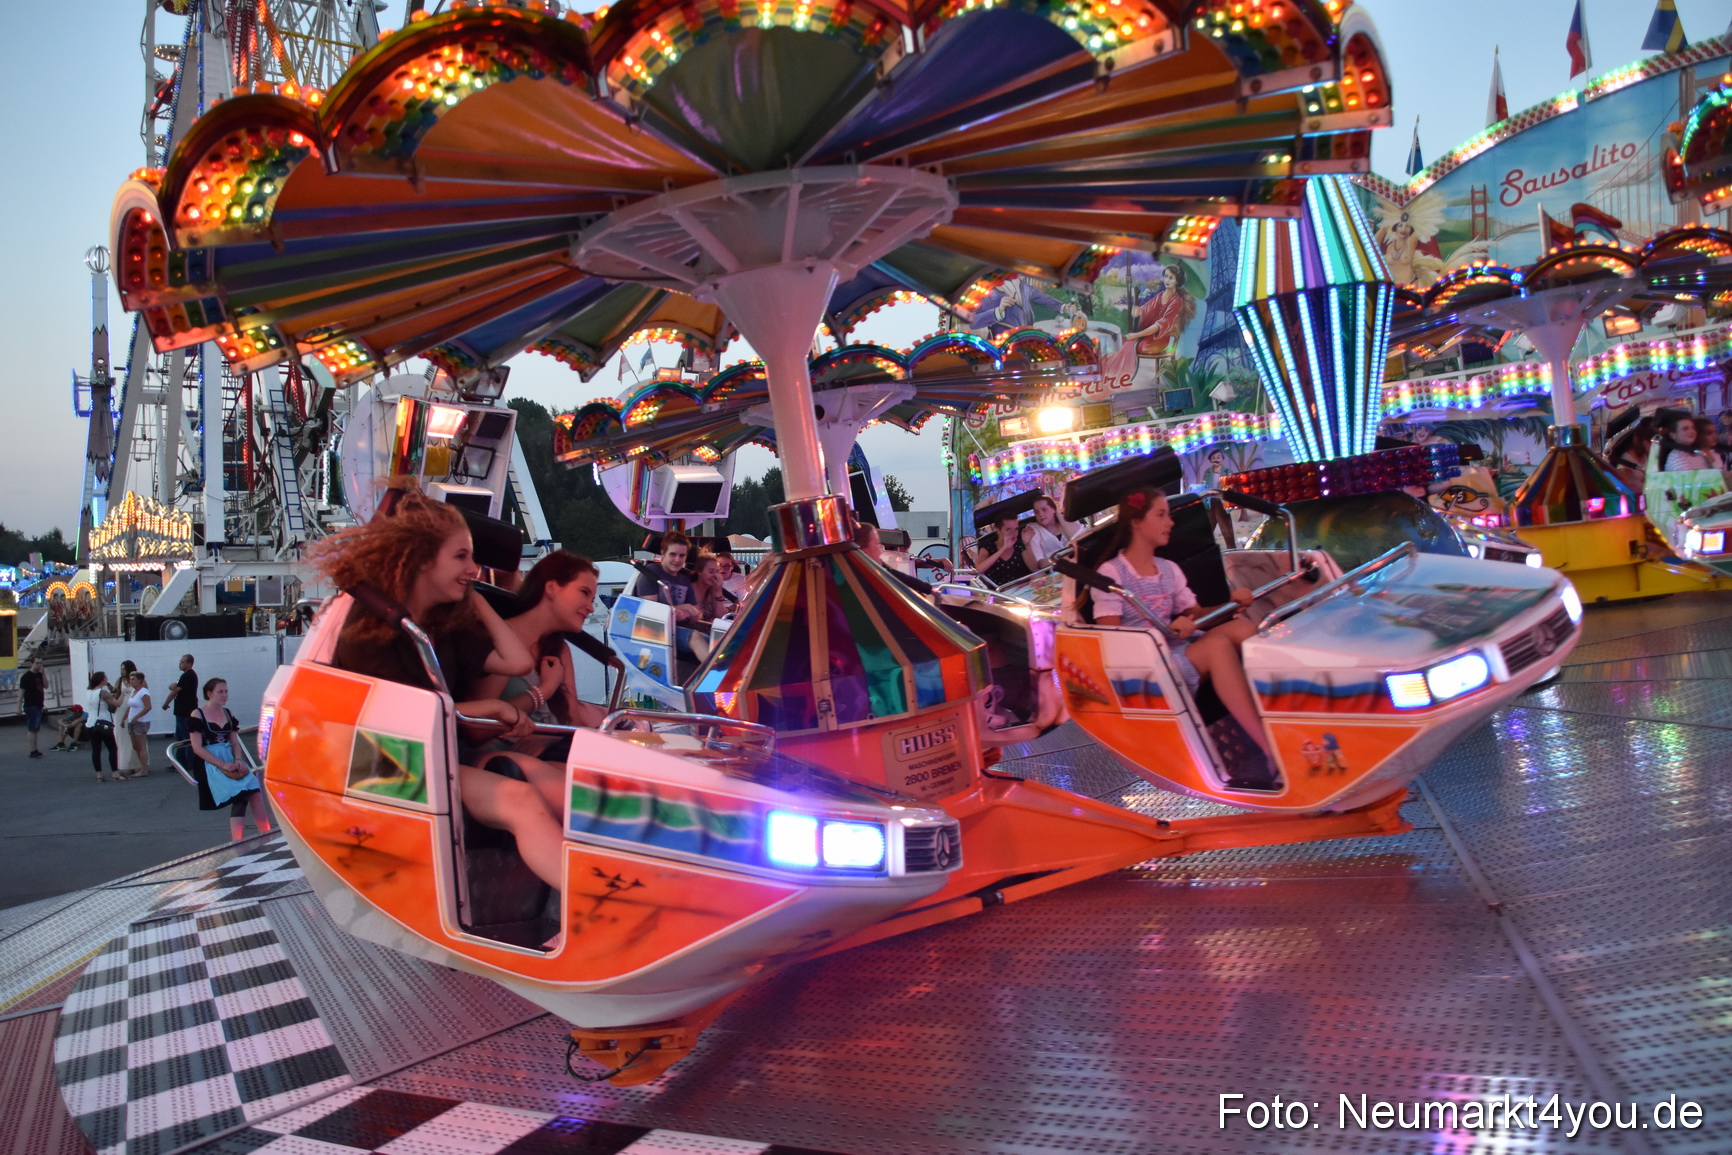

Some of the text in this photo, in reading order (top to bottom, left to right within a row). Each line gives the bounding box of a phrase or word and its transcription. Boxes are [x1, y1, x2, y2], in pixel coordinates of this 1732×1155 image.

[1499, 142, 1636, 207] Sausalito
[901, 725, 956, 754] HUSS
[904, 760, 962, 786] 2800 BREMEN
